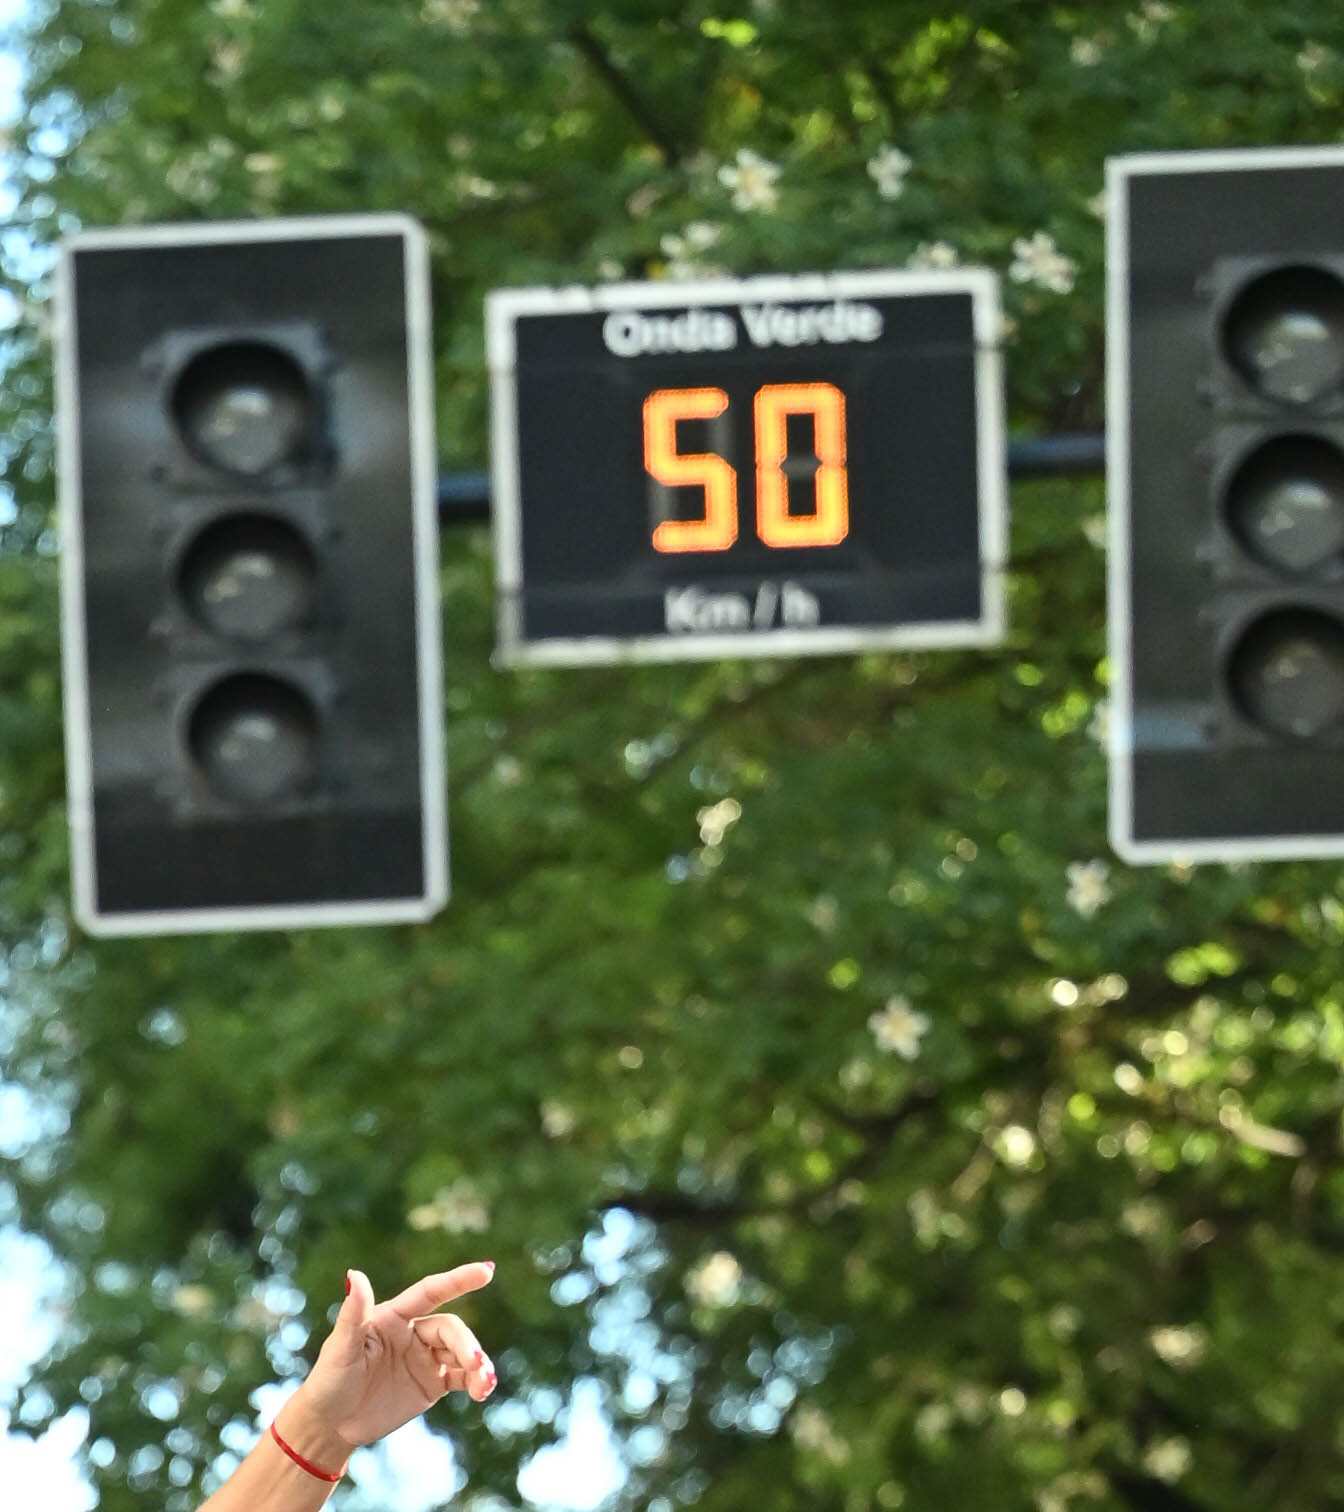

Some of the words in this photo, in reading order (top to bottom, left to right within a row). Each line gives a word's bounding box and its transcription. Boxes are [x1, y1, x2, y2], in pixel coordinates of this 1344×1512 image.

[603, 305, 737, 357] Onda
[743, 301, 883, 346] Verde
[643, 382, 849, 554] 50
